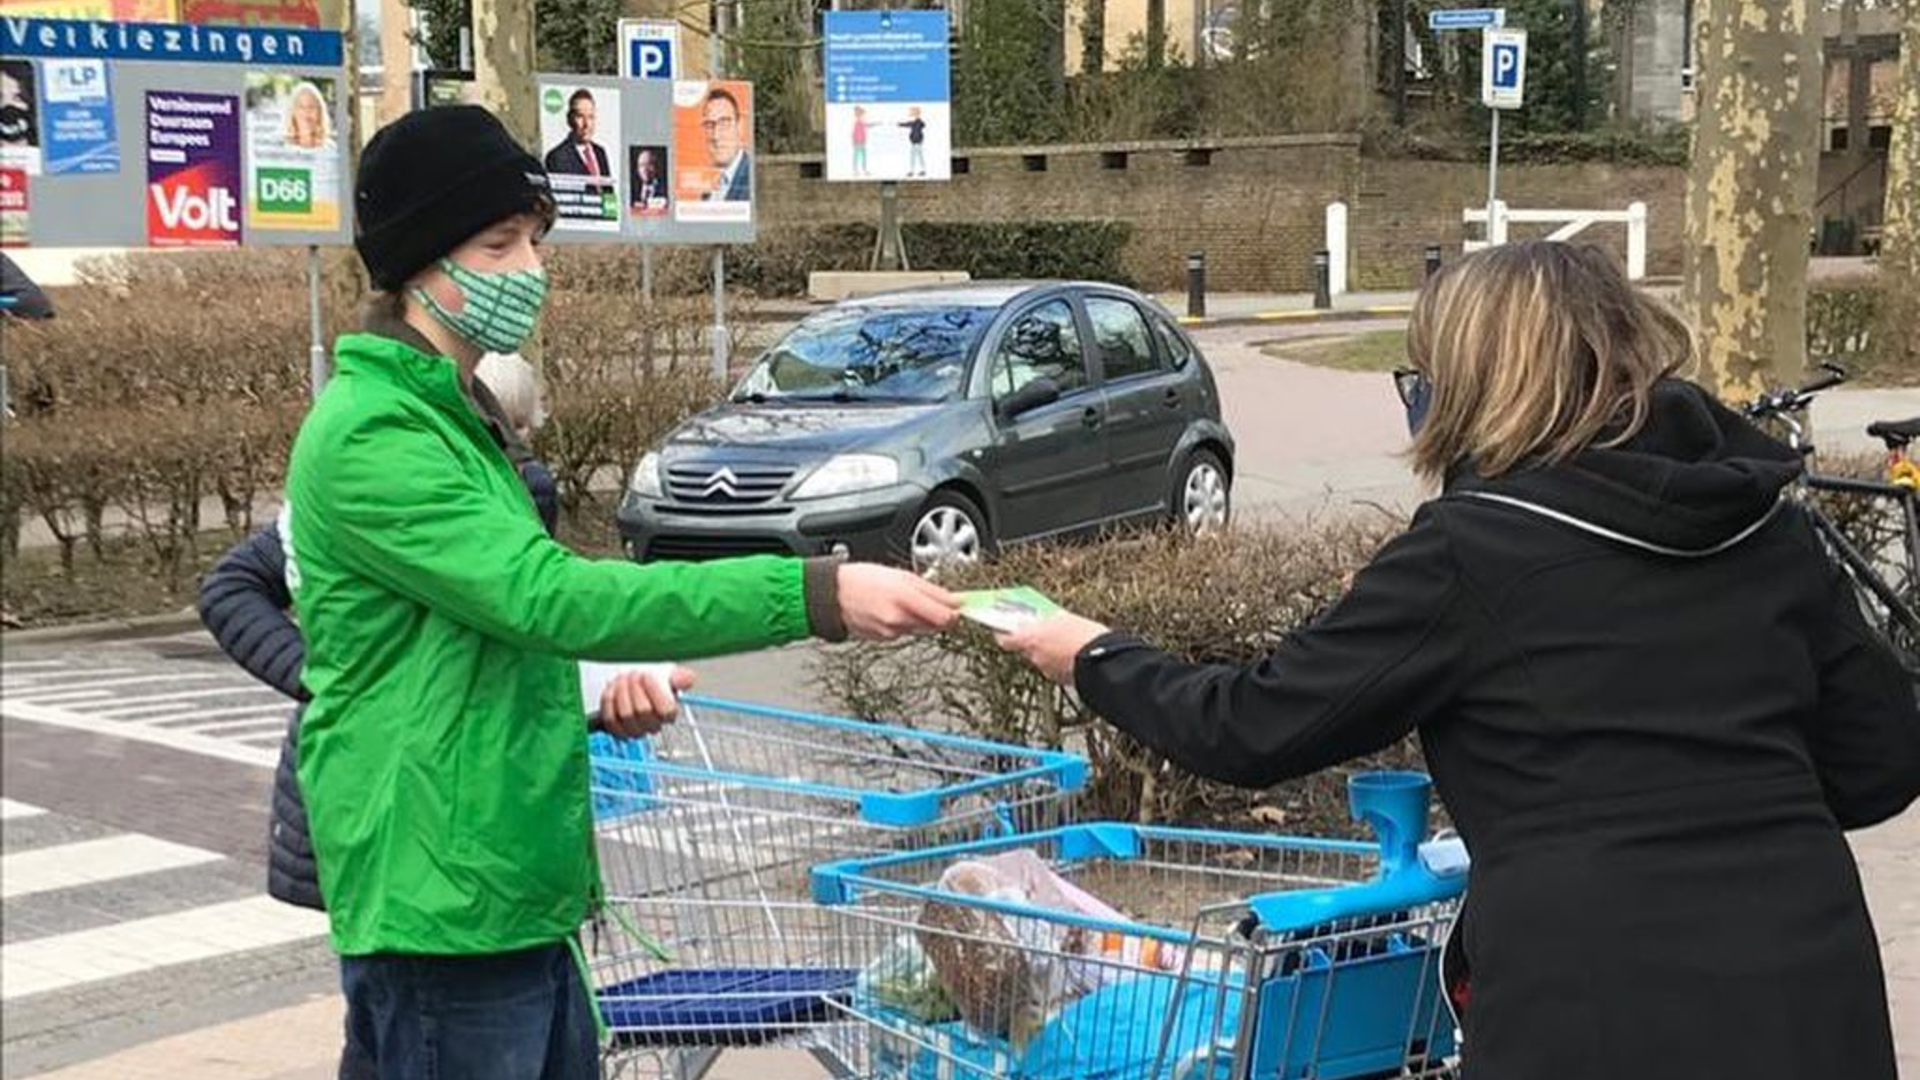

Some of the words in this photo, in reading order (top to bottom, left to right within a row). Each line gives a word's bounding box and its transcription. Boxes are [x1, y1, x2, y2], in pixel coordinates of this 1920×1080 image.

[5, 18, 304, 60] Verkiezingen
[640, 45, 663, 79] P
[1497, 48, 1514, 83] P
[151, 183, 238, 231] Volt
[260, 178, 307, 202] D66
